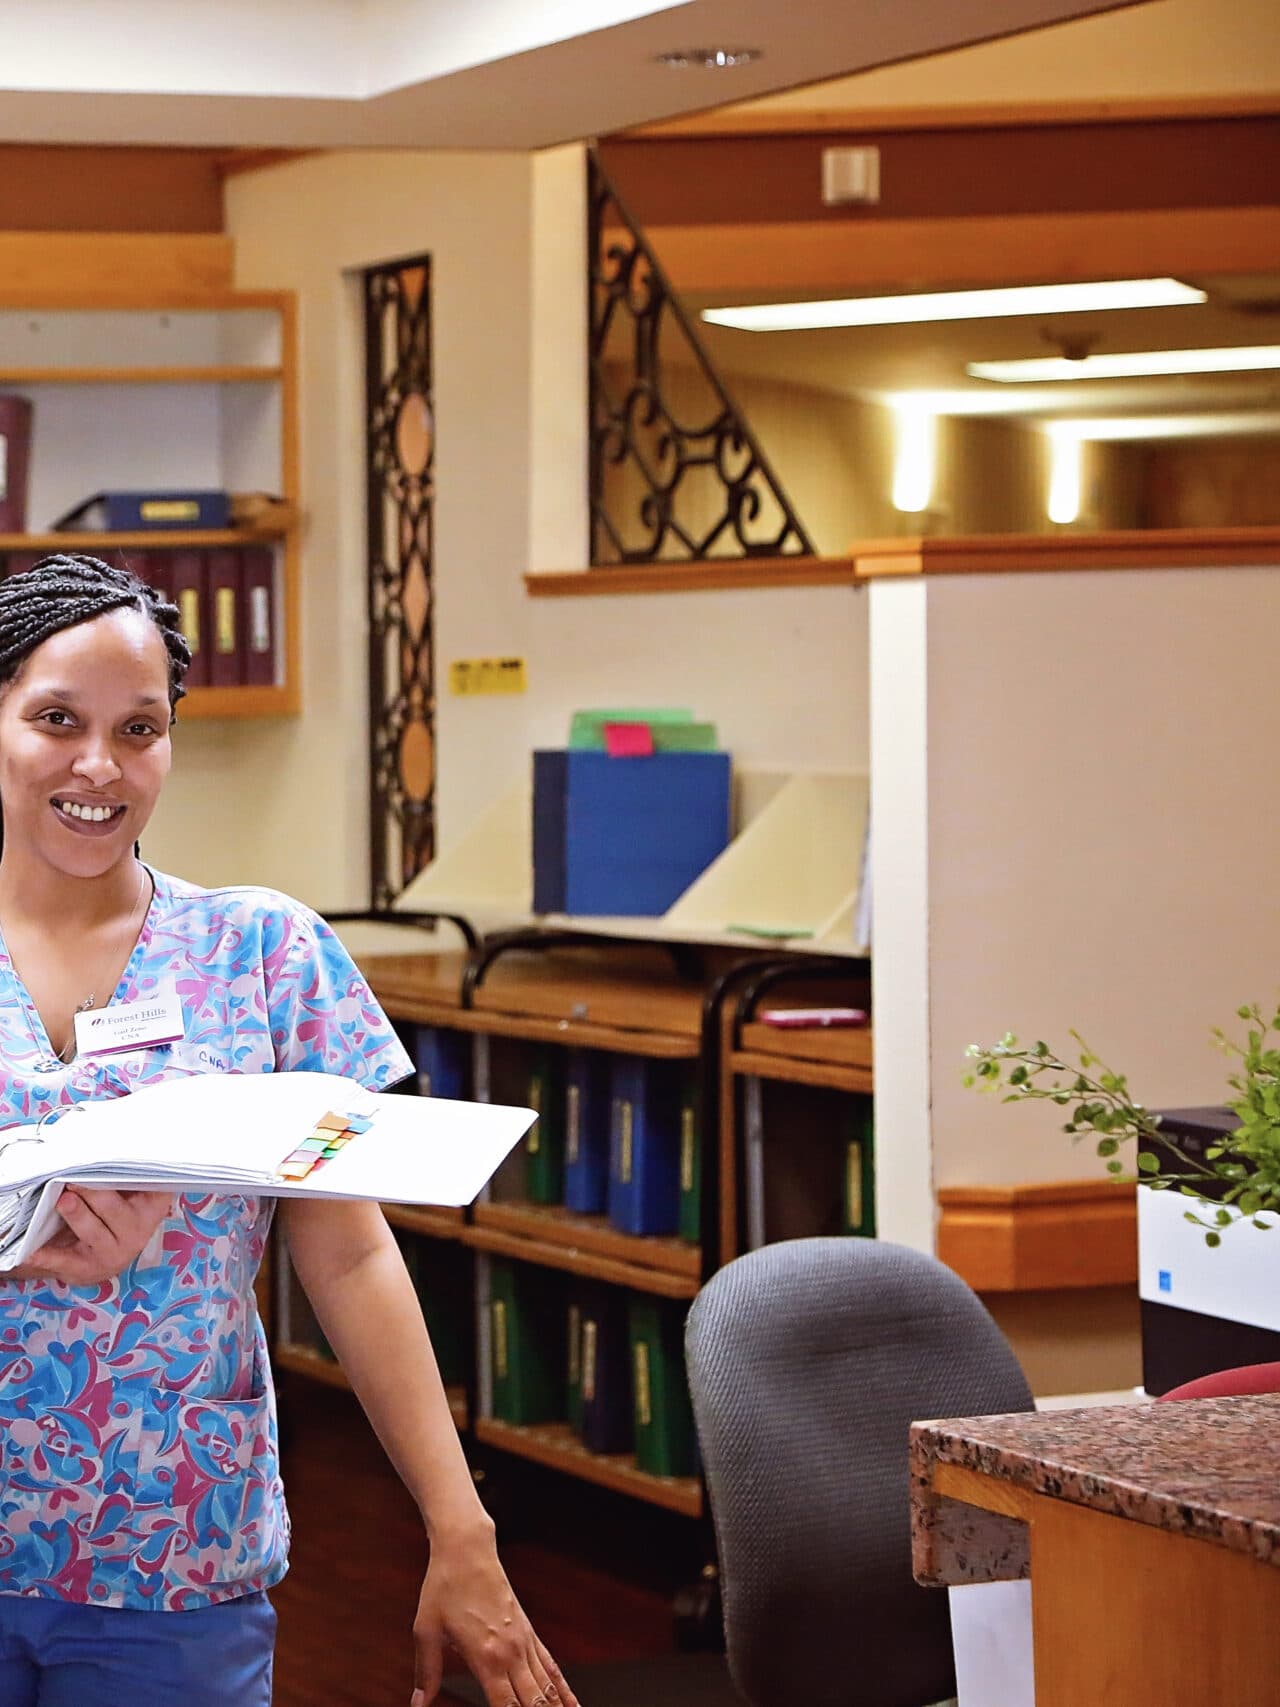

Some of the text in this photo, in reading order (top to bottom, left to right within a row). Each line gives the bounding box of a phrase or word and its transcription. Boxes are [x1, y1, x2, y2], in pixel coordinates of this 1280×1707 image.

[107, 1008, 167, 1025] Forest Hills
[199, 1050, 226, 1071] CNA
